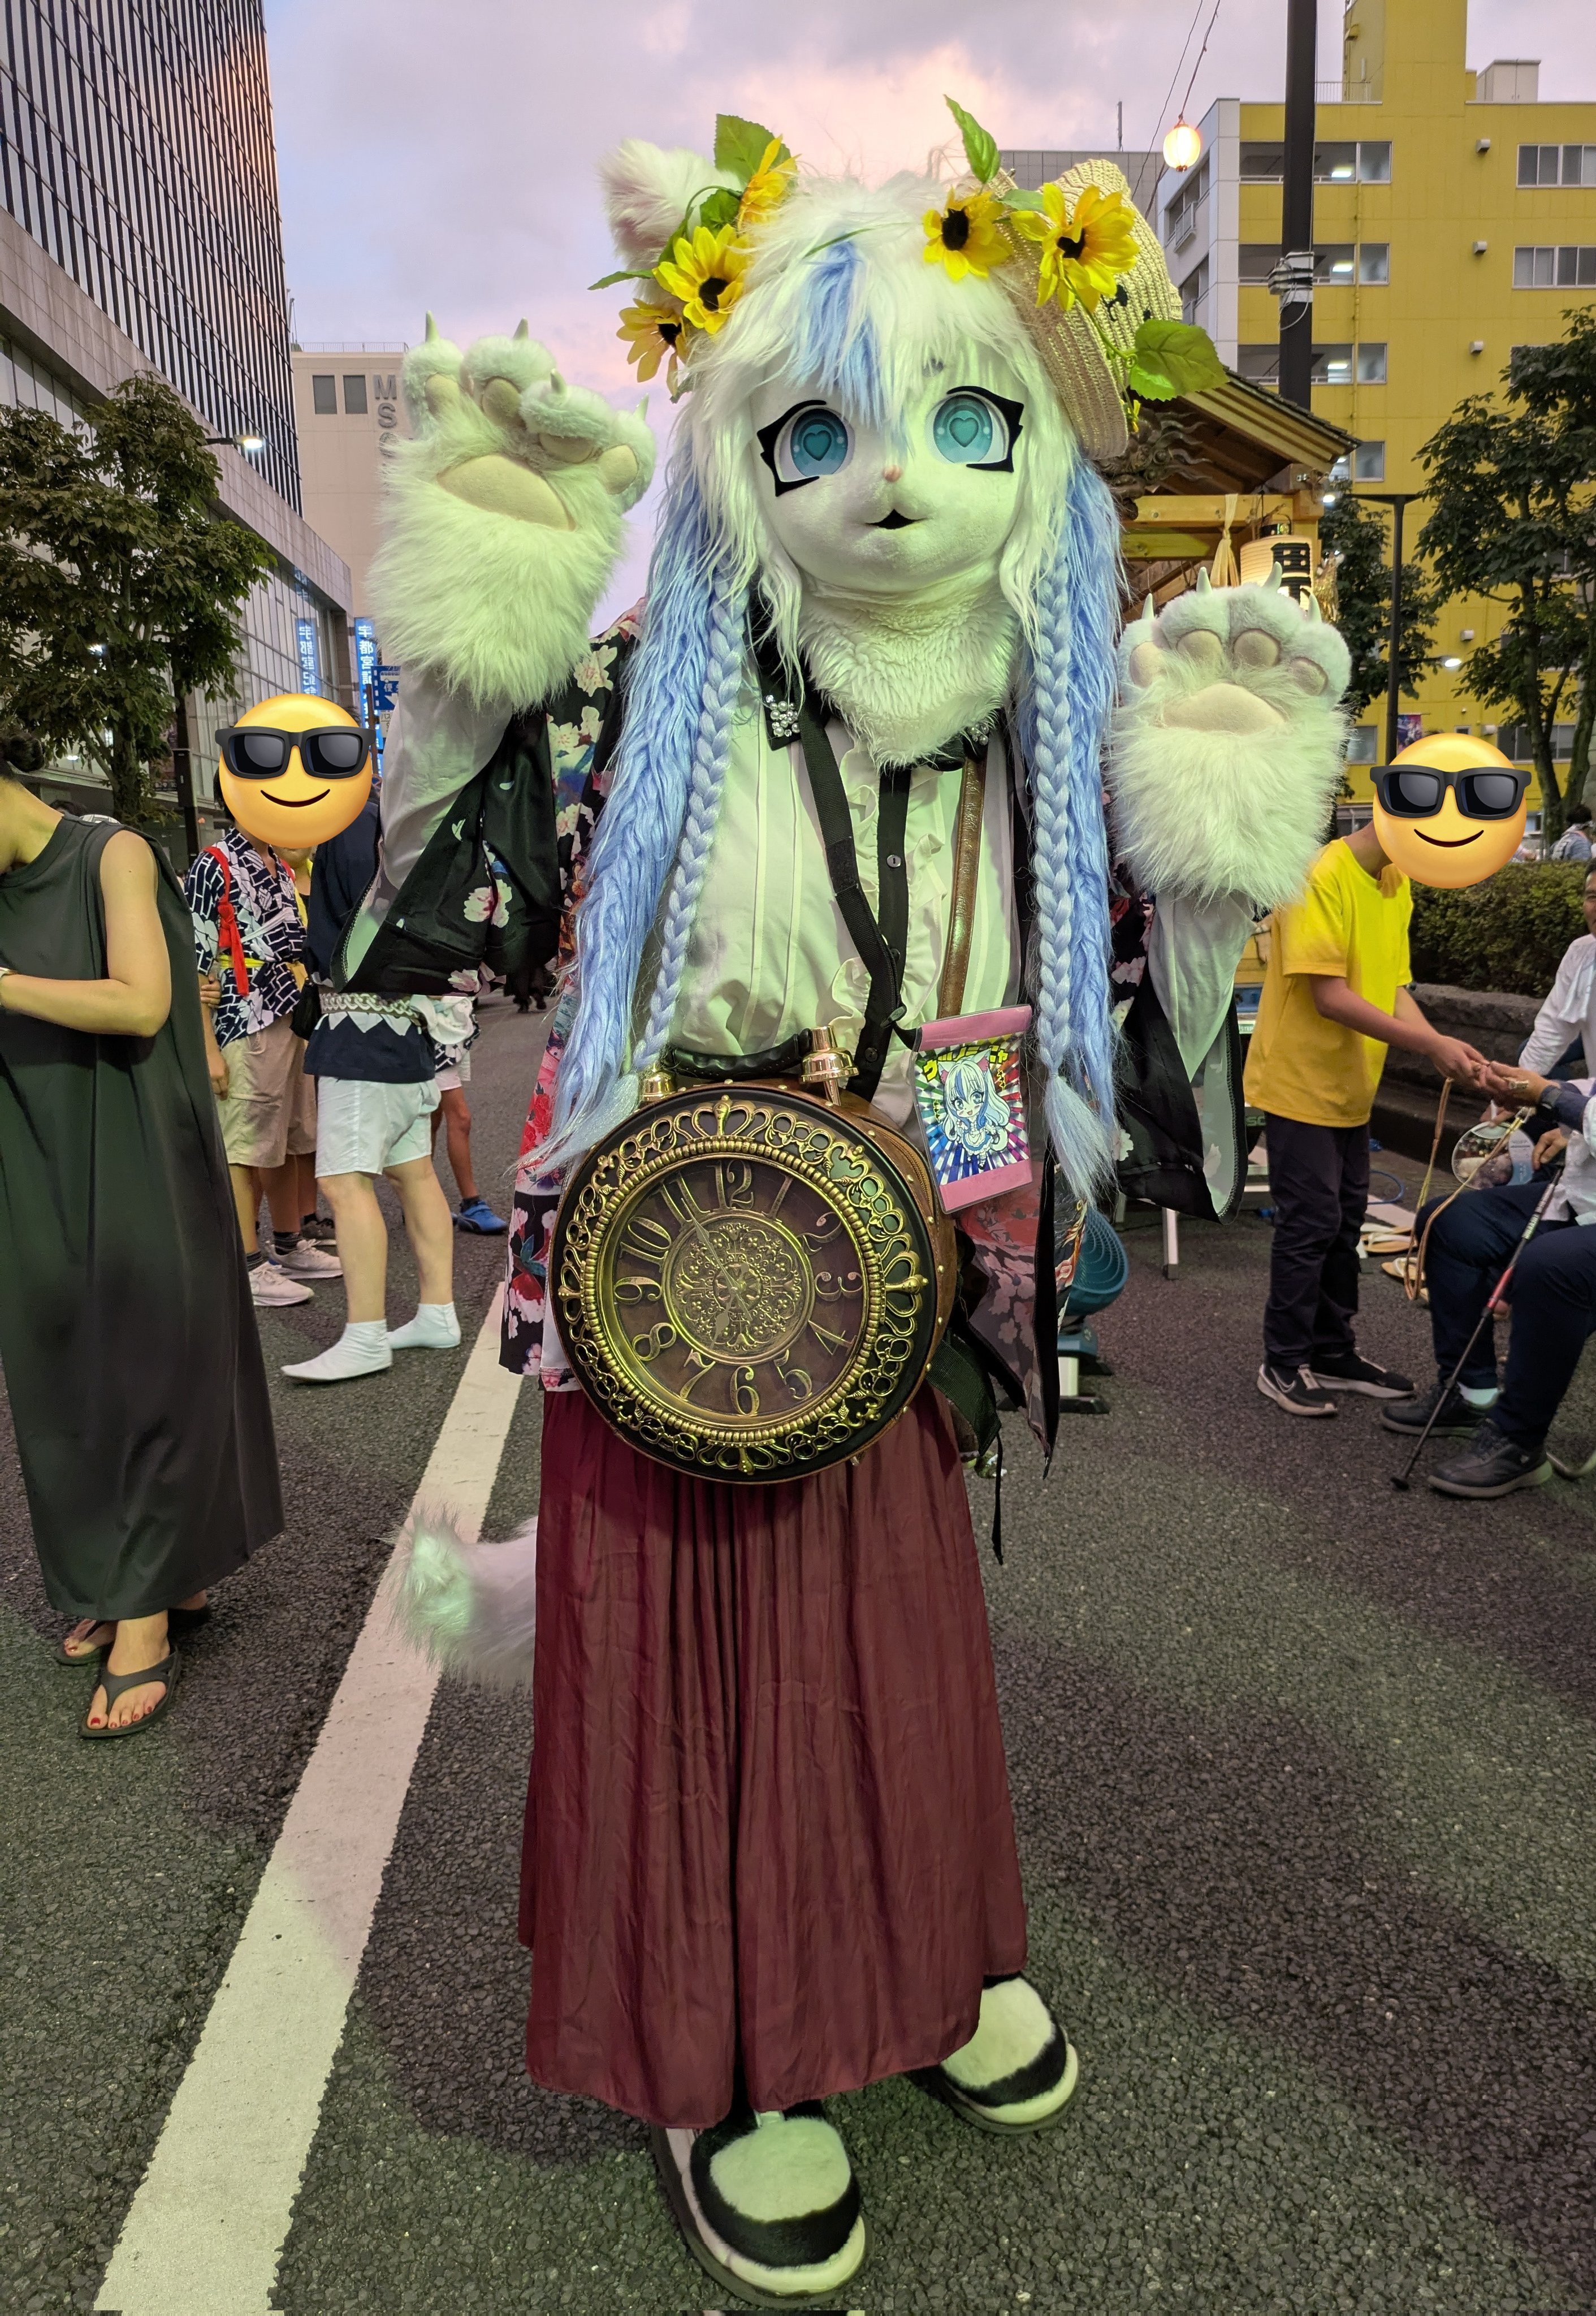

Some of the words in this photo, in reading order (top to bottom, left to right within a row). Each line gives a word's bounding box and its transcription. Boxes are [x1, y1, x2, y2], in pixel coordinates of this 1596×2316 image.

[650, 1172, 711, 1228] 11
[706, 1159, 754, 1210] 12
[761, 1170, 794, 1223] 1
[620, 1216, 672, 1274] 10
[796, 1211, 843, 1255] 2
[614, 1276, 663, 1305] 9
[815, 1272, 864, 1302] 3
[632, 1322, 677, 1362] 8
[808, 1320, 858, 1357] 4
[680, 1349, 716, 1402] 7
[730, 1366, 760, 1417] 6
[773, 1349, 813, 1401] 5
